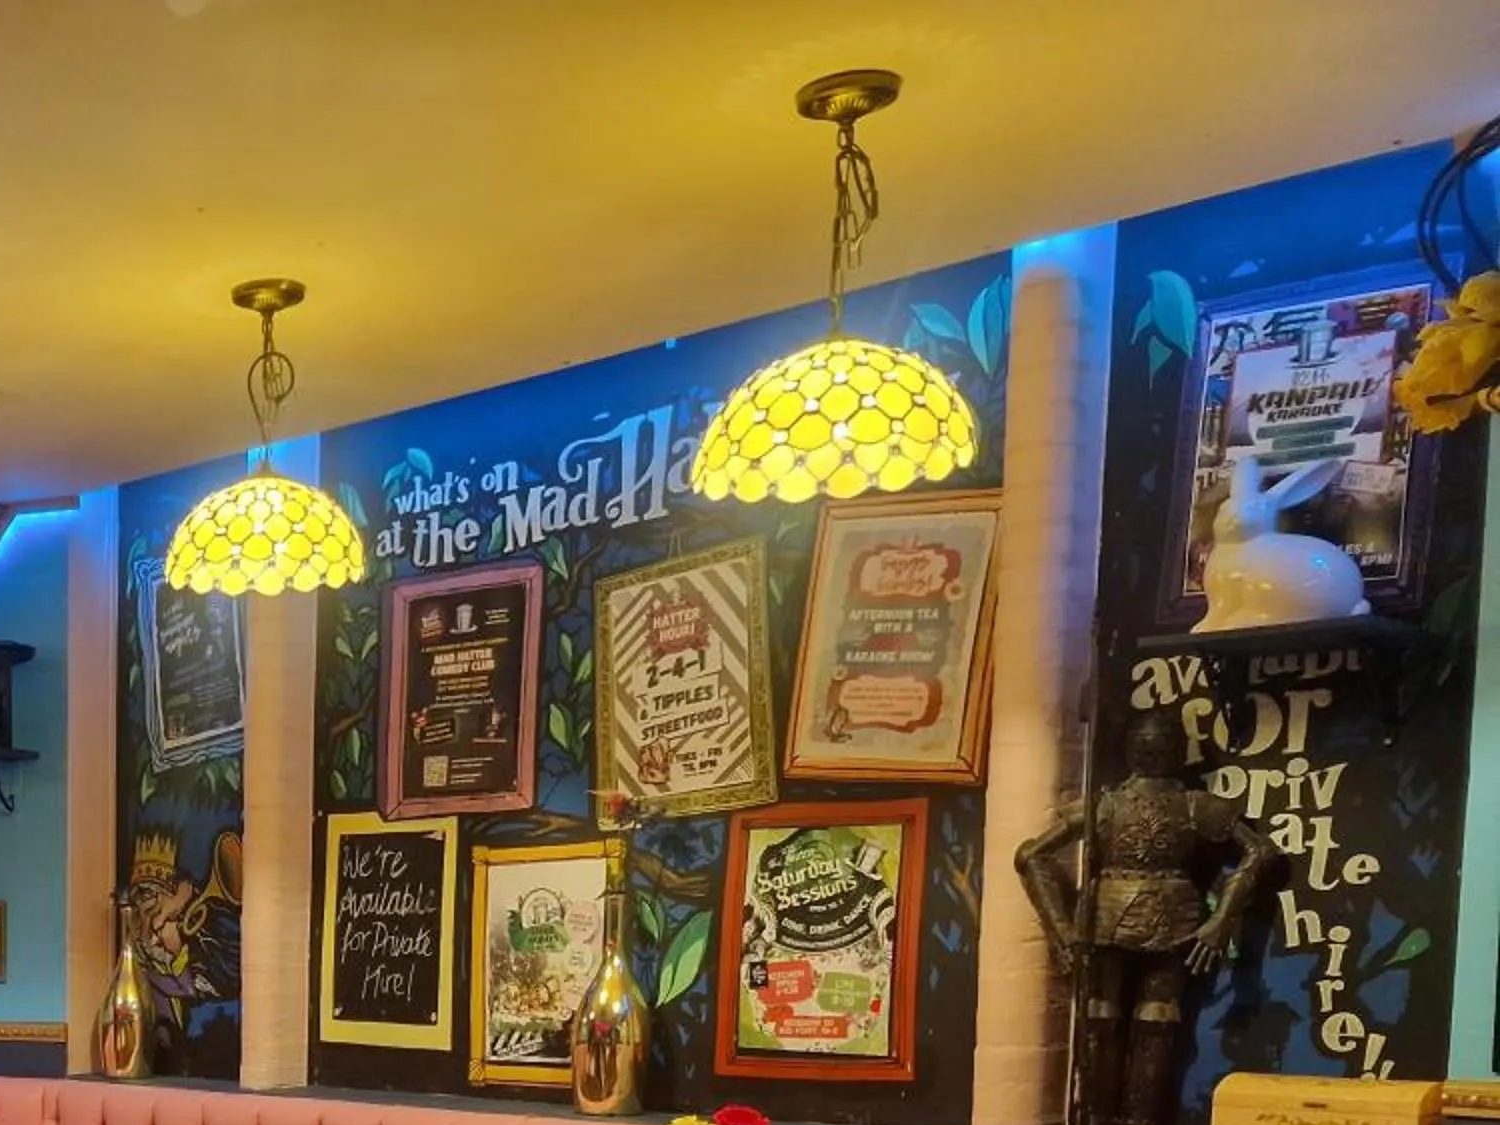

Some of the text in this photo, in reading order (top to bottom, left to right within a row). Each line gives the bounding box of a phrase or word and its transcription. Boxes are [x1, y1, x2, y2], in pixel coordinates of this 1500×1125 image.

[1267, 402, 1343, 423] KARAOKE
[394, 462, 518, 515] what's on
[376, 523, 405, 558] at
[413, 515, 479, 568] the
[499, 459, 599, 554] Mad
[653, 607, 699, 629] HATTER
[849, 607, 939, 621] AFTERNOON TEA
[471, 659, 495, 671] CLUB
[646, 650, 705, 689] 2-4-1
[652, 684, 714, 712] TIPPLES
[641, 706, 723, 741] STREETFOOD
[1182, 688, 1332, 765] for
[343, 845, 408, 879] We're
[758, 859, 843, 894] Saturday
[776, 875, 857, 911] Sessions
[341, 920, 434, 964] for Private
[361, 963, 416, 1001] Hire!
